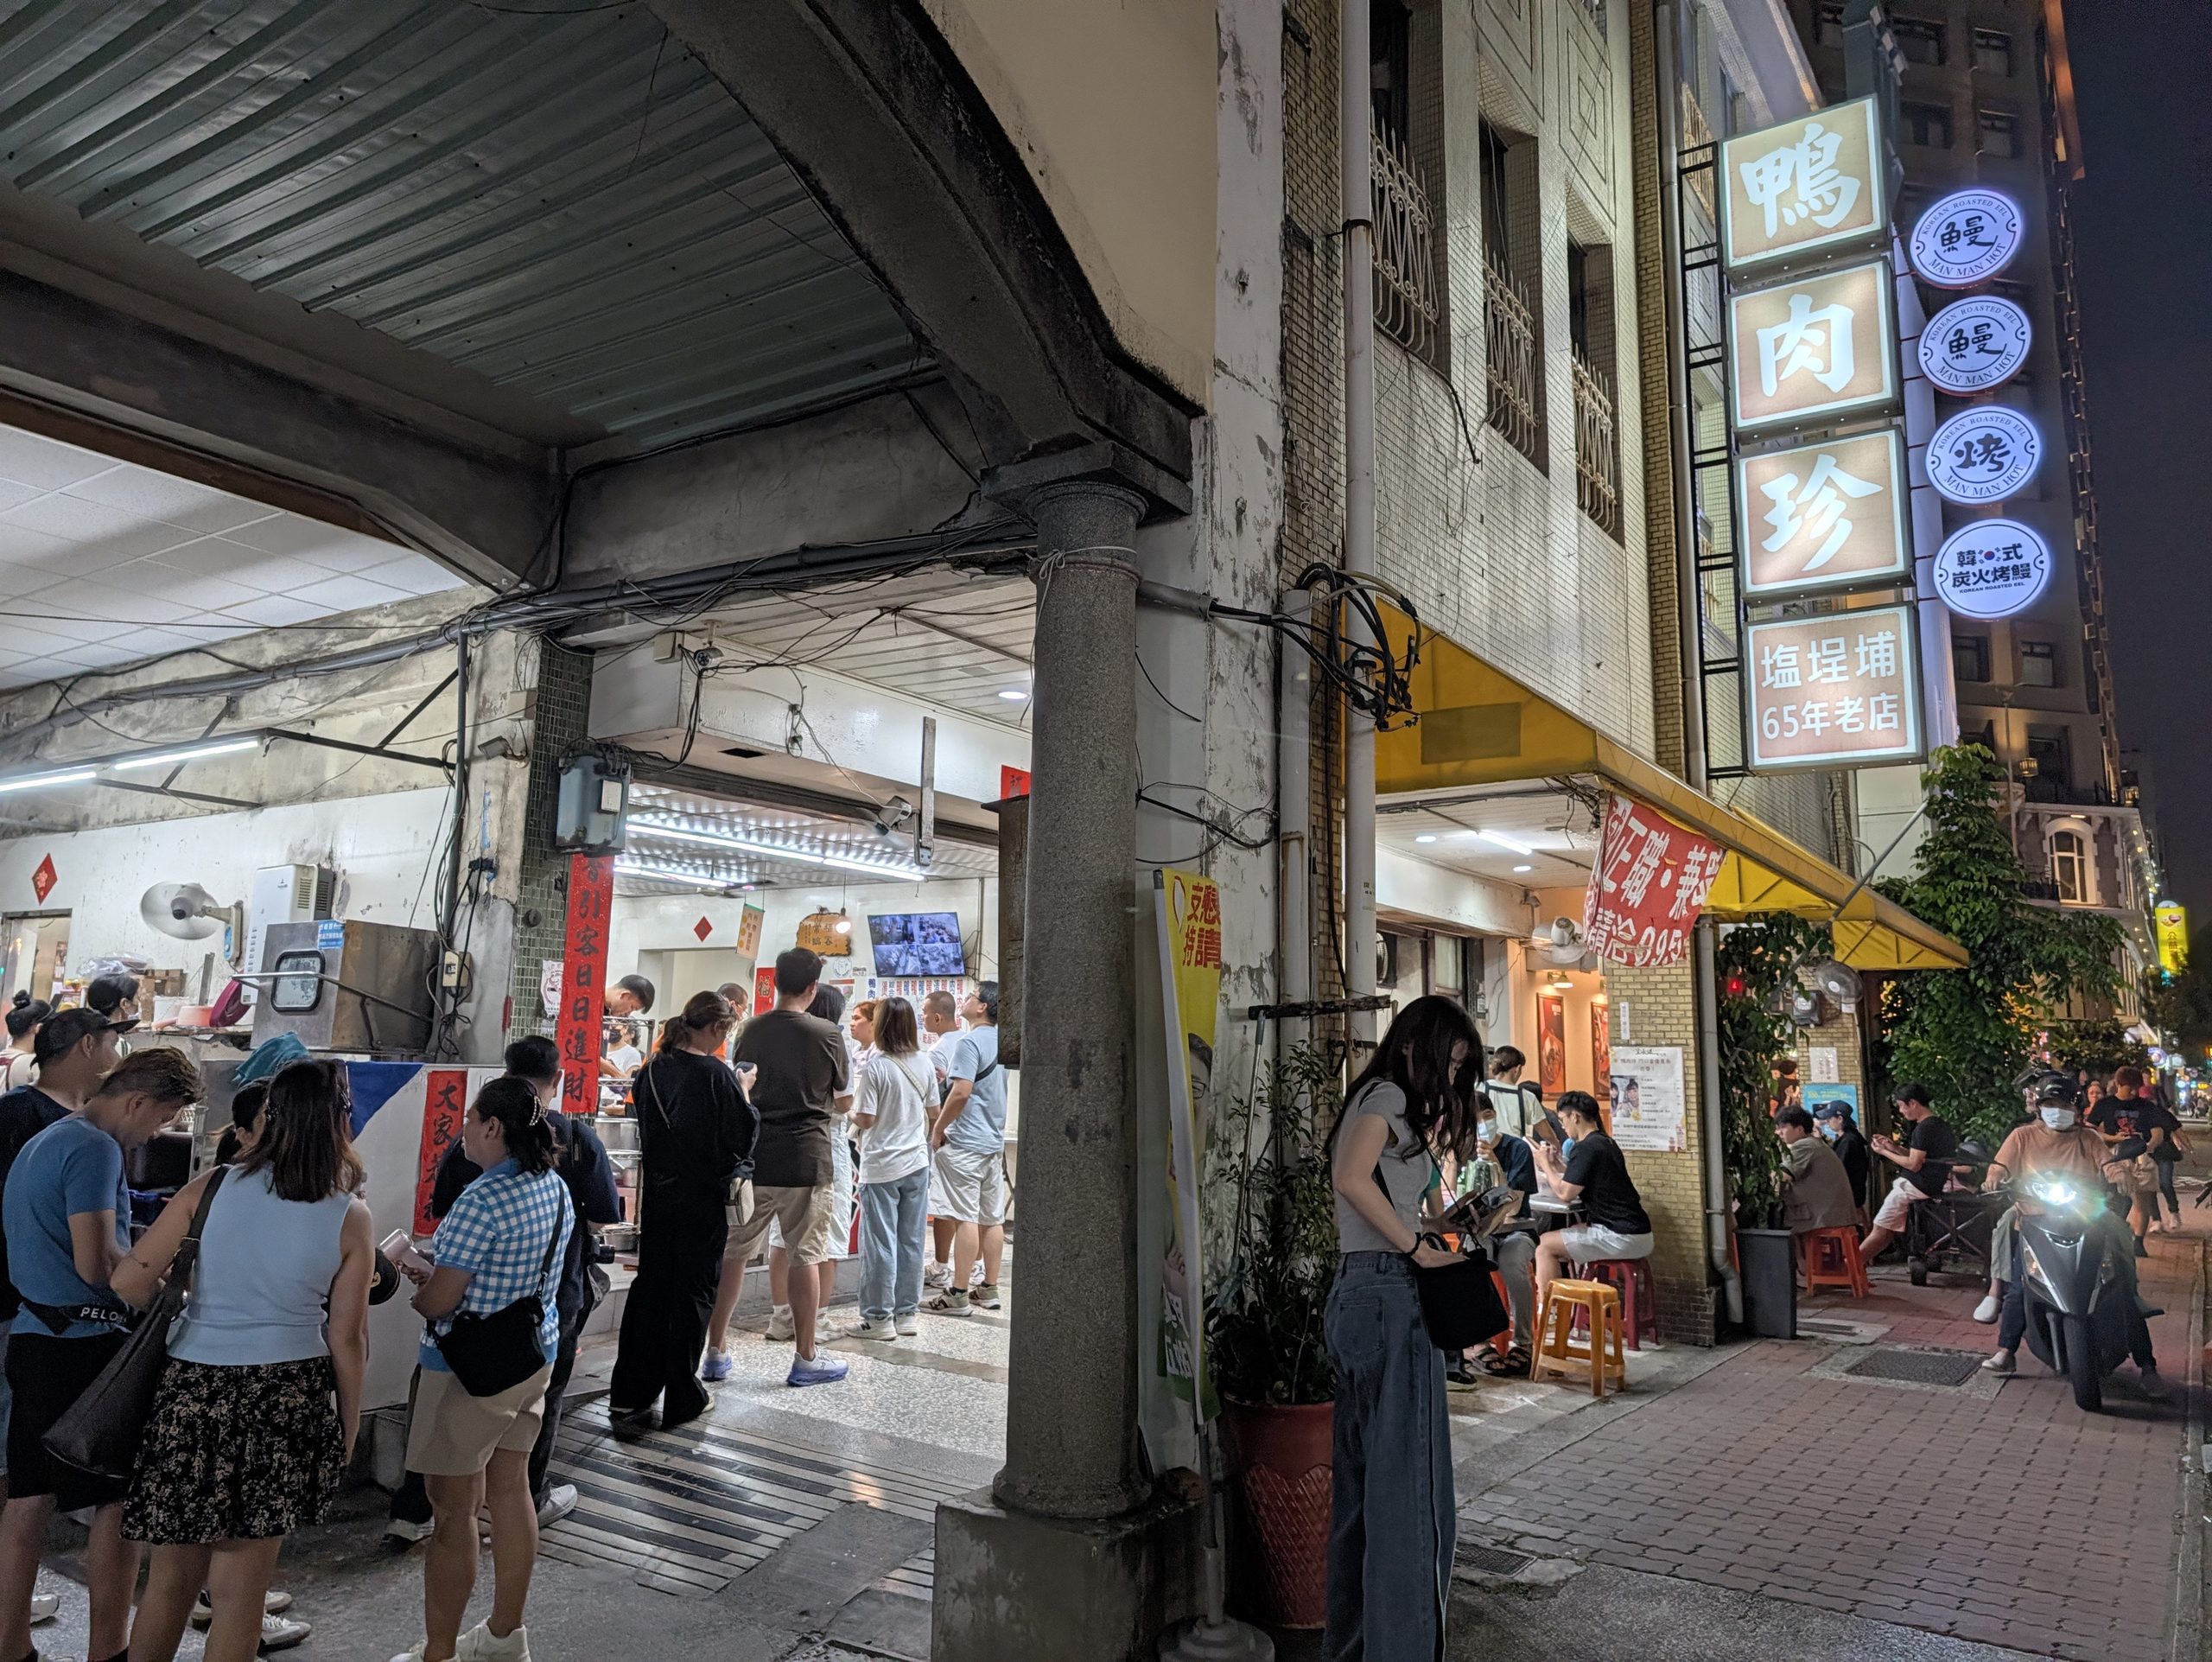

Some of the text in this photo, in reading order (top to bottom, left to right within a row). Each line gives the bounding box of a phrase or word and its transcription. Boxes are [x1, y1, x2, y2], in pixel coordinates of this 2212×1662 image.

[1922, 199, 2007, 235] KOREAN ROASTED EEL
[1941, 215, 1994, 253] 鰻
[1929, 243, 2005, 277] MAN MAN HOT
[1929, 305, 2017, 341] KOREAN ROASTED EEL
[1948, 322, 2003, 360] 鰻
[1936, 351, 2015, 385] MAN MAN HOT
[1937, 416, 2026, 449] KOREAN ROASTED EEL
[1943, 463, 2024, 495] MAN MAN HOT
[1952, 563, 2031, 588] 炭火烤鰻
[1760, 631, 1897, 690] 塩埕埔
[1762, 692, 1898, 741] 65年老店
[1182, 882, 1204, 966] 支持
